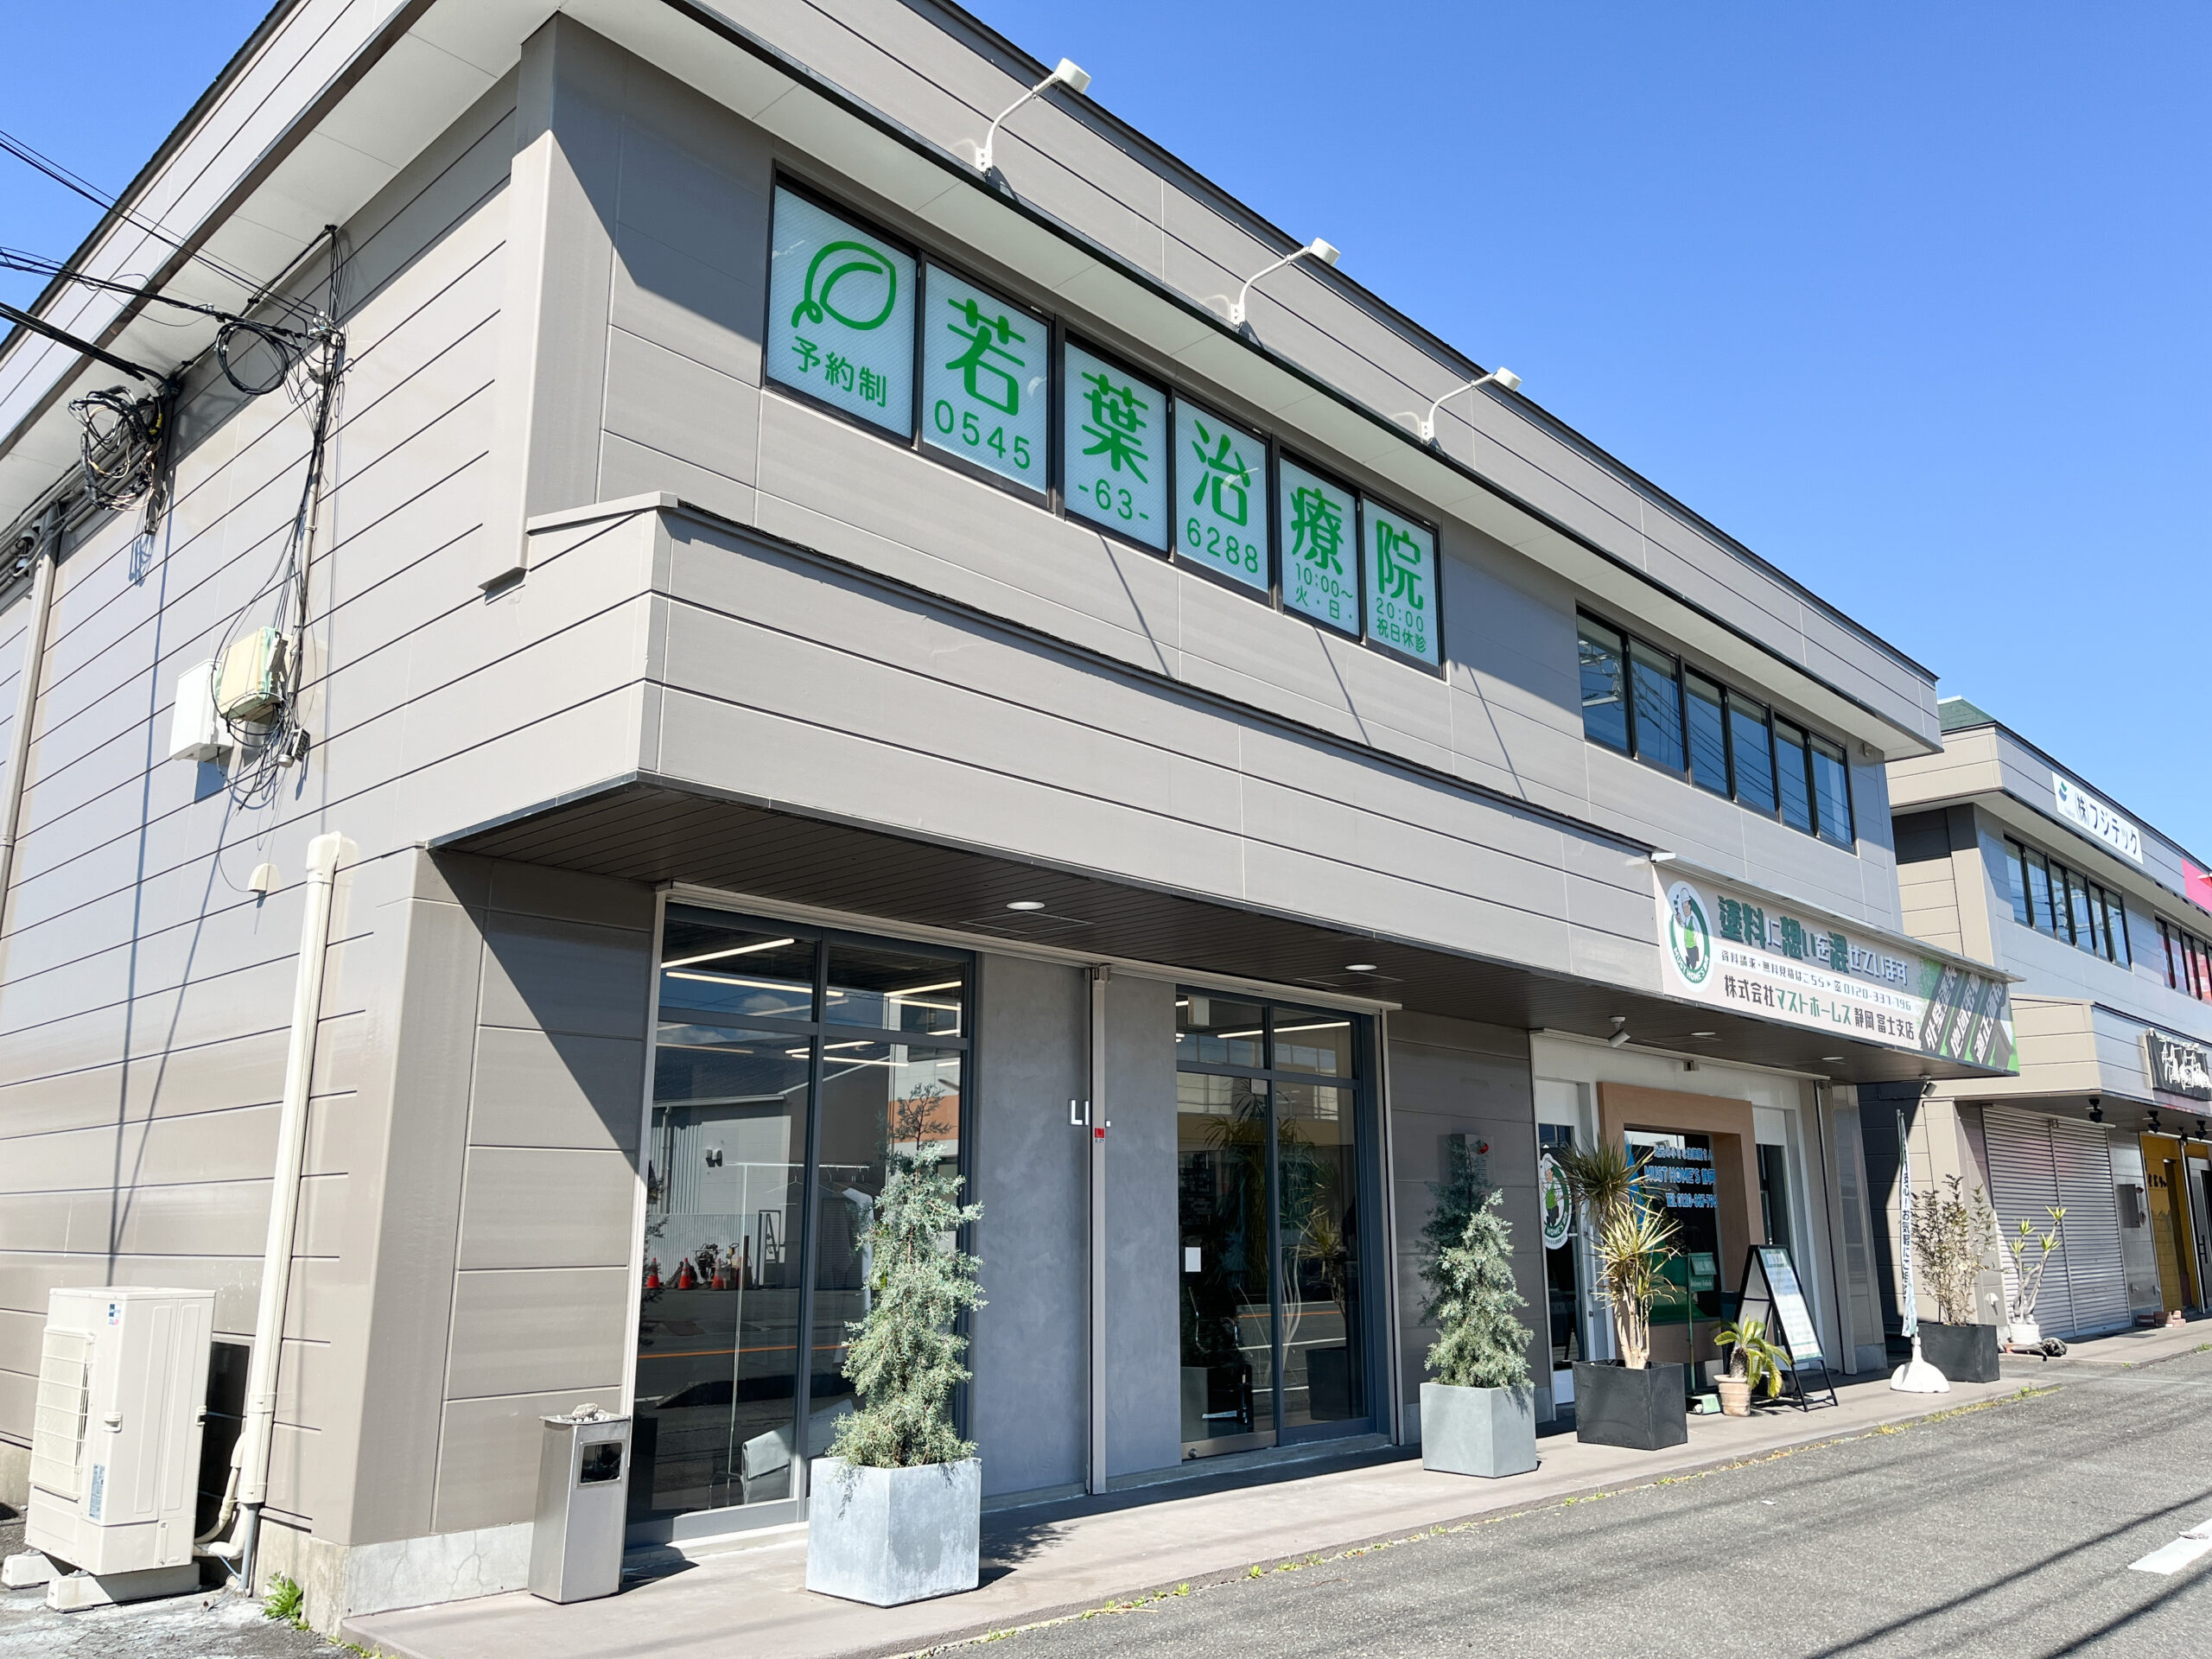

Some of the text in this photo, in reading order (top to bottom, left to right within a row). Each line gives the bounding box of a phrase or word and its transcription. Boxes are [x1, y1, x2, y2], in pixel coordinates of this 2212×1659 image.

[791, 336, 887, 408] 予約制
[945, 298, 1424, 611] 若葉治療院
[1643, 1165, 1668, 1183] MUST
[1669, 1166, 1701, 1185] HOME'S
